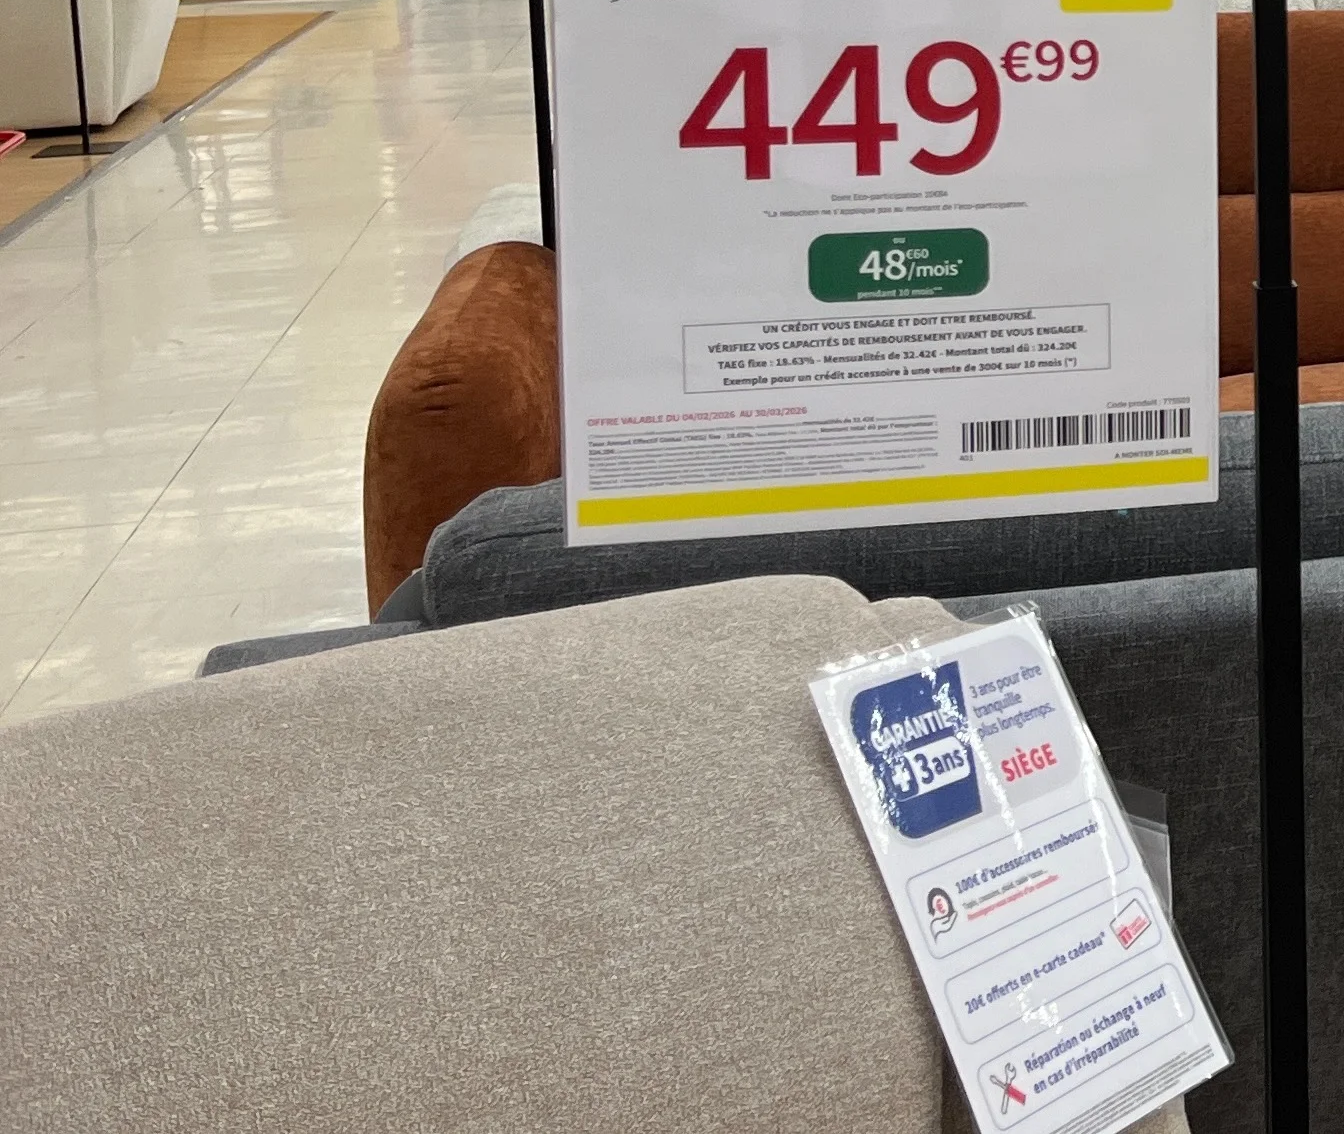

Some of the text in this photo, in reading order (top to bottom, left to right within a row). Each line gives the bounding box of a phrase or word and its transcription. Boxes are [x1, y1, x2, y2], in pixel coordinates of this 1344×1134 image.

[858, 248, 908, 282] 48
[762, 324, 779, 334] UN
[781, 321, 819, 334] CRÉDIT
[822, 321, 850, 331] VOUS
[853, 319, 895, 330] ENGAGE
[897, 318, 910, 327] ET
[913, 316, 938, 327] DOIT
[708, 342, 756, 354] VÉRIFIEZ
[759, 341, 780, 351] VOS
[782, 336, 840, 350] CAPACITÉS
[842, 337, 855, 347] DE
[858, 332, 953, 346] REMBOURSEMENT
[954, 330, 988, 341] AVANT
[990, 329, 1004, 338] DE
[1006, 327, 1035, 337] VOUS
[718, 360, 745, 370] TAEG
[747, 359, 768, 369] fixe
[823, 351, 886, 364] Mensualités
[887, 351, 900, 361] de
[945, 347, 989, 358] Montant
[991, 345, 1015, 355] total
[723, 376, 768, 387] Exemple
[770, 374, 796, 386] pour
[798, 374, 812, 382] un
[814, 369, 845, 381] crédit
[911, 367, 931, 376] une
[932, 365, 961, 375] vente
[963, 363, 977, 373] de
[1005, 362, 1021, 371] sur
[978, 680, 997, 696] ans
[997, 671, 1021, 694] pour
[1021, 665, 1043, 681] être
[973, 691, 1023, 719] tranquille
[871, 706, 955, 753] GARANTIE
[932, 748, 965, 776] ans
[1001, 742, 1058, 782] SIÈGE
[986, 978, 1020, 1003] offerts
[1019, 971, 1033, 986] en
[1023, 982, 1168, 1074] Réparation ou échange à neuf
[1033, 1079, 1047, 1095] en
[1047, 1068, 1065, 1087] cas
